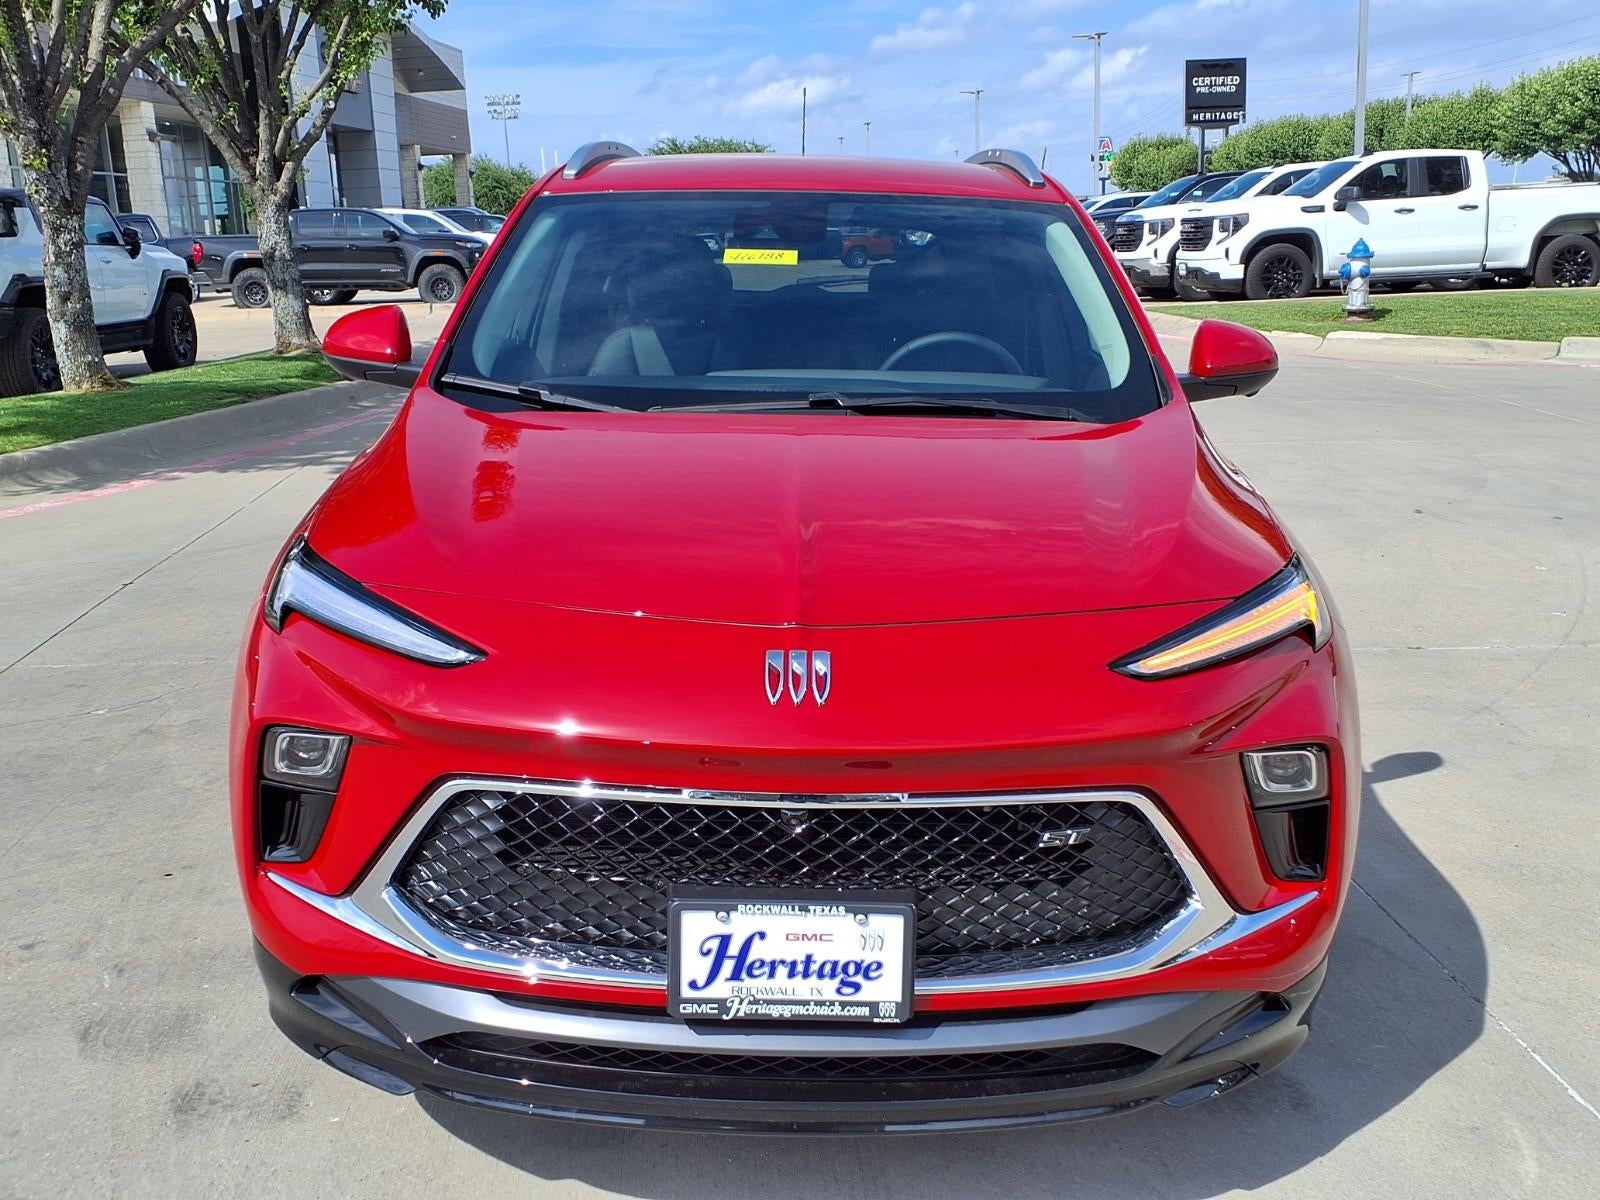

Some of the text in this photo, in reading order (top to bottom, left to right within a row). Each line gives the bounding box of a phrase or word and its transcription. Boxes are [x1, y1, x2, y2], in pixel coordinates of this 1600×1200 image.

[1192, 76, 1241, 87] CERTIFIED
[1196, 85, 1236, 94] PRE-OWNED
[1192, 111, 1241, 121] HERITAGE
[737, 904, 846, 917] ROCKWALL, TEXAS
[785, 933, 834, 942] GMC
[687, 931, 884, 997] Heritage
[808, 987, 823, 997] TX
[679, 1003, 719, 1014] GMC
[722, 995, 870, 1020] Heritagegmcbuick.com
